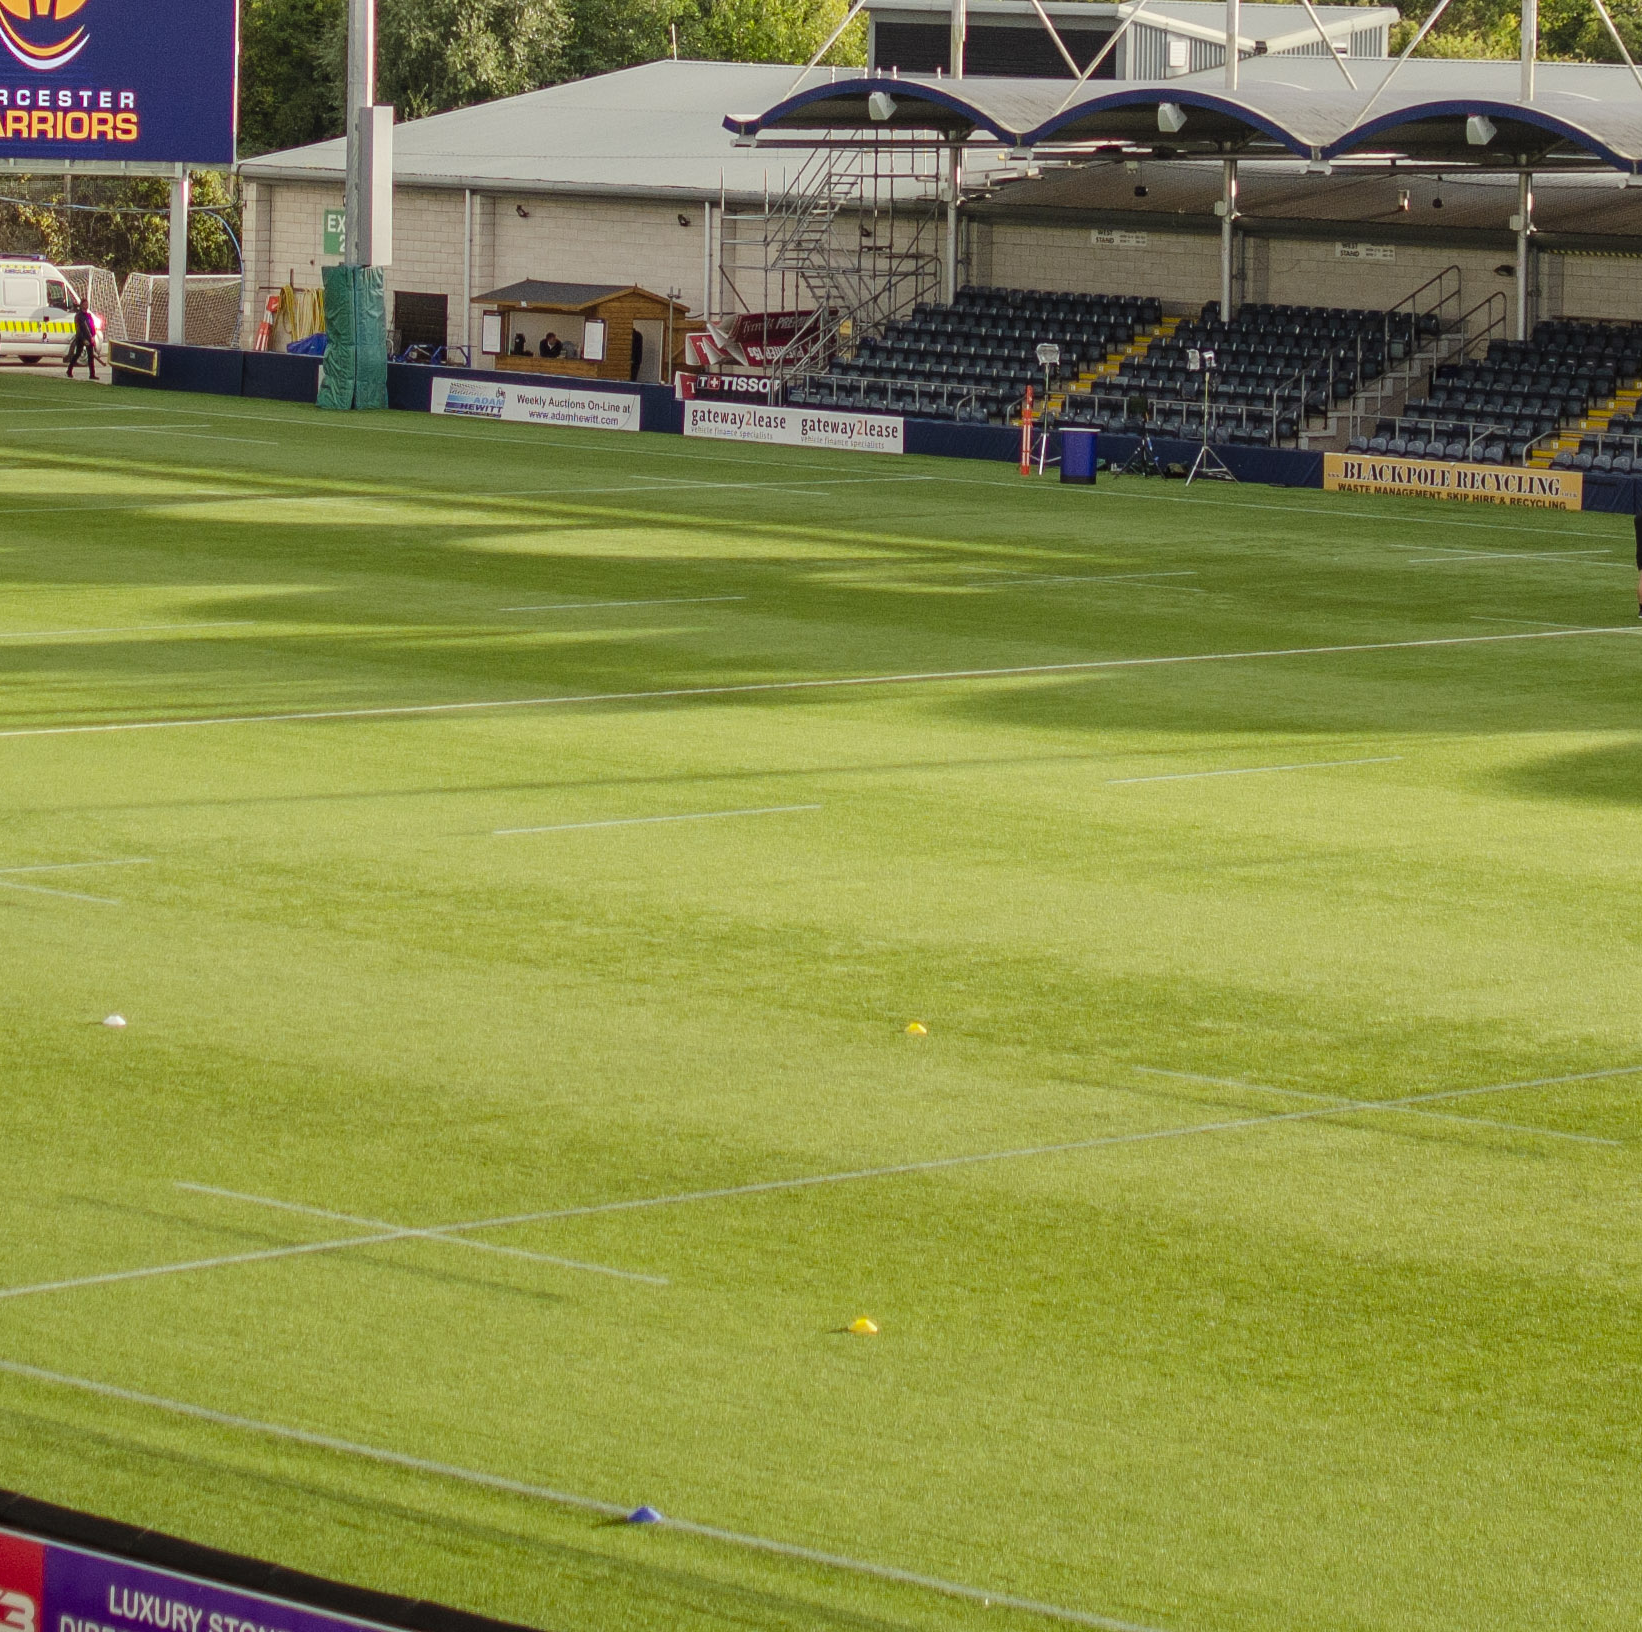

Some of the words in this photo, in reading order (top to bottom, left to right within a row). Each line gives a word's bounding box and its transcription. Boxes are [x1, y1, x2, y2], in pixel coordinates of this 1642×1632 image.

[328, 214, 346, 233] EX
[459, 403, 504, 413] HEWITT
[473, 396, 506, 406] ADAM
[517, 394, 547, 407] Weekly
[548, 398, 586, 410] Auctions
[588, 400, 621, 414] On-Line
[622, 404, 631, 414] at
[528, 409, 619, 426] www.adamhewitt.com
[691, 408, 786, 429] gateway2lease
[801, 417, 898, 439] gateway2lease
[1343, 461, 1451, 488] BLACKPOLE
[1456, 470, 1562, 497] RECYCLING
[1338, 483, 1371, 494] WASTE
[1447, 491, 1469, 502] SKIP
[1472, 493, 1496, 504] HIRE
[1499, 495, 1506, 505] &
[1509, 497, 1567, 510] RECYCLING
[109, 1584, 203, 1632] LUXURY
